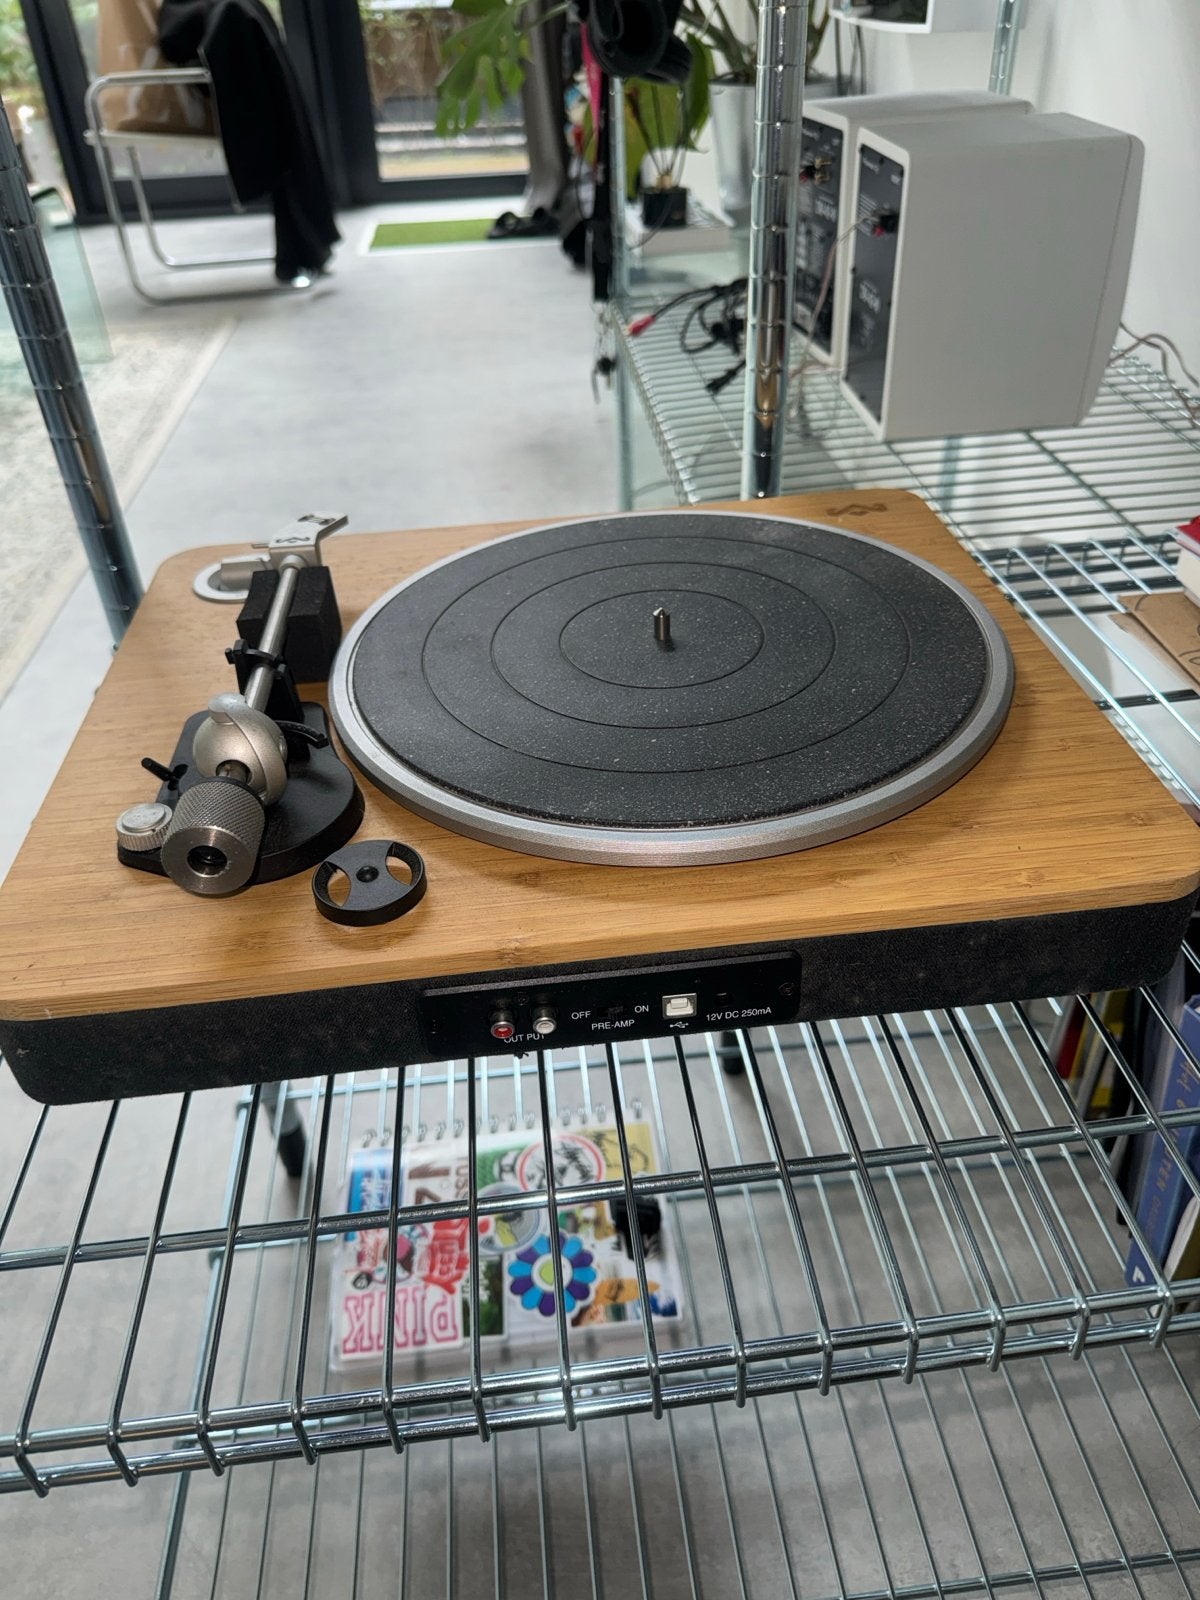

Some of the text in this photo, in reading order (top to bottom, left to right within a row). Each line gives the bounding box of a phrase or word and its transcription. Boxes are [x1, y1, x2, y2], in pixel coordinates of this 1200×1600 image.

[571, 1010, 592, 1020] OFF
[634, 1004, 649, 1014] ON
[706, 1006, 772, 1022] 12V DC 250mA
[591, 1019, 635, 1031] PRE-AMP
[342, 1285, 458, 1354] PINK
